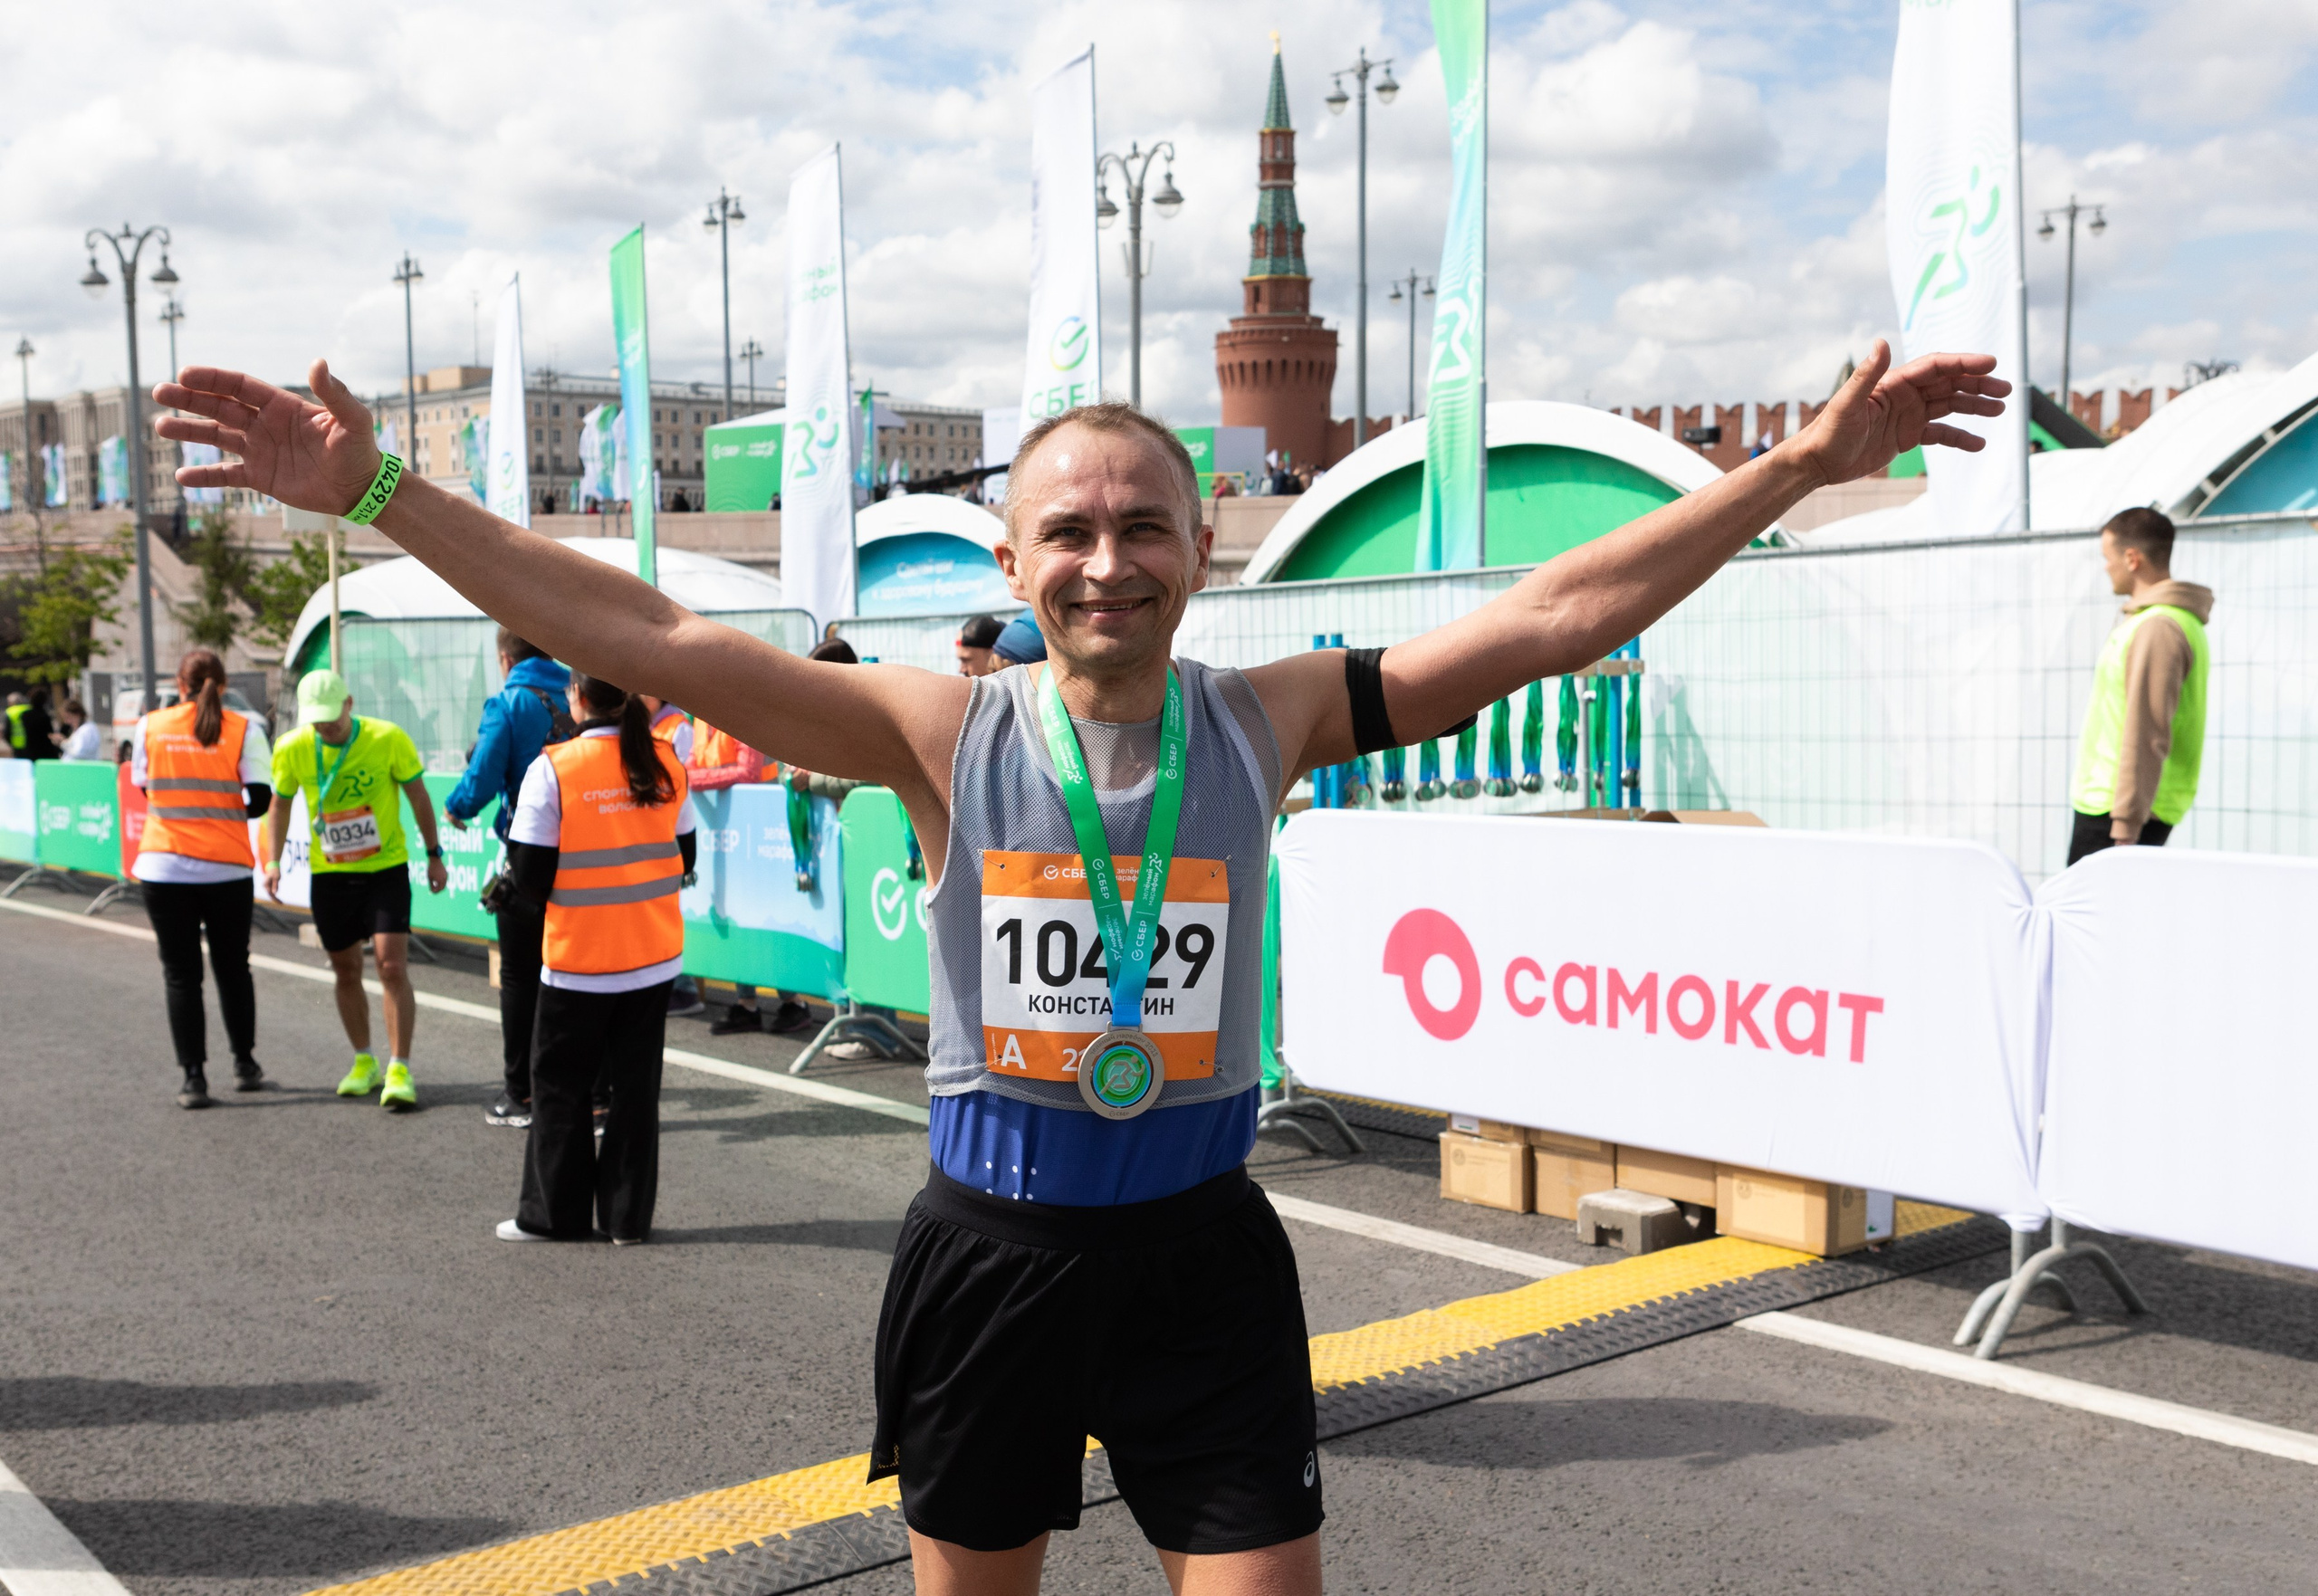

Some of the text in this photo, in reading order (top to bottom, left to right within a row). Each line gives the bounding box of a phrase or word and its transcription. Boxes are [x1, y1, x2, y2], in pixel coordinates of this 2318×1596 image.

[371, 453, 402, 504] 10429
[1047, 704, 1060, 727] СБЕР
[1168, 743, 1178, 767] СБЕР
[407, 855, 478, 899] мафон
[1061, 867, 1087, 879] СБЕ
[1097, 872, 1110, 900] СБЕР
[1142, 867, 1154, 902] зелёный
[1148, 872, 1160, 906] марафон
[1135, 920, 1148, 947] СБЕР
[1029, 994, 1174, 1016] КОНСТАИН
